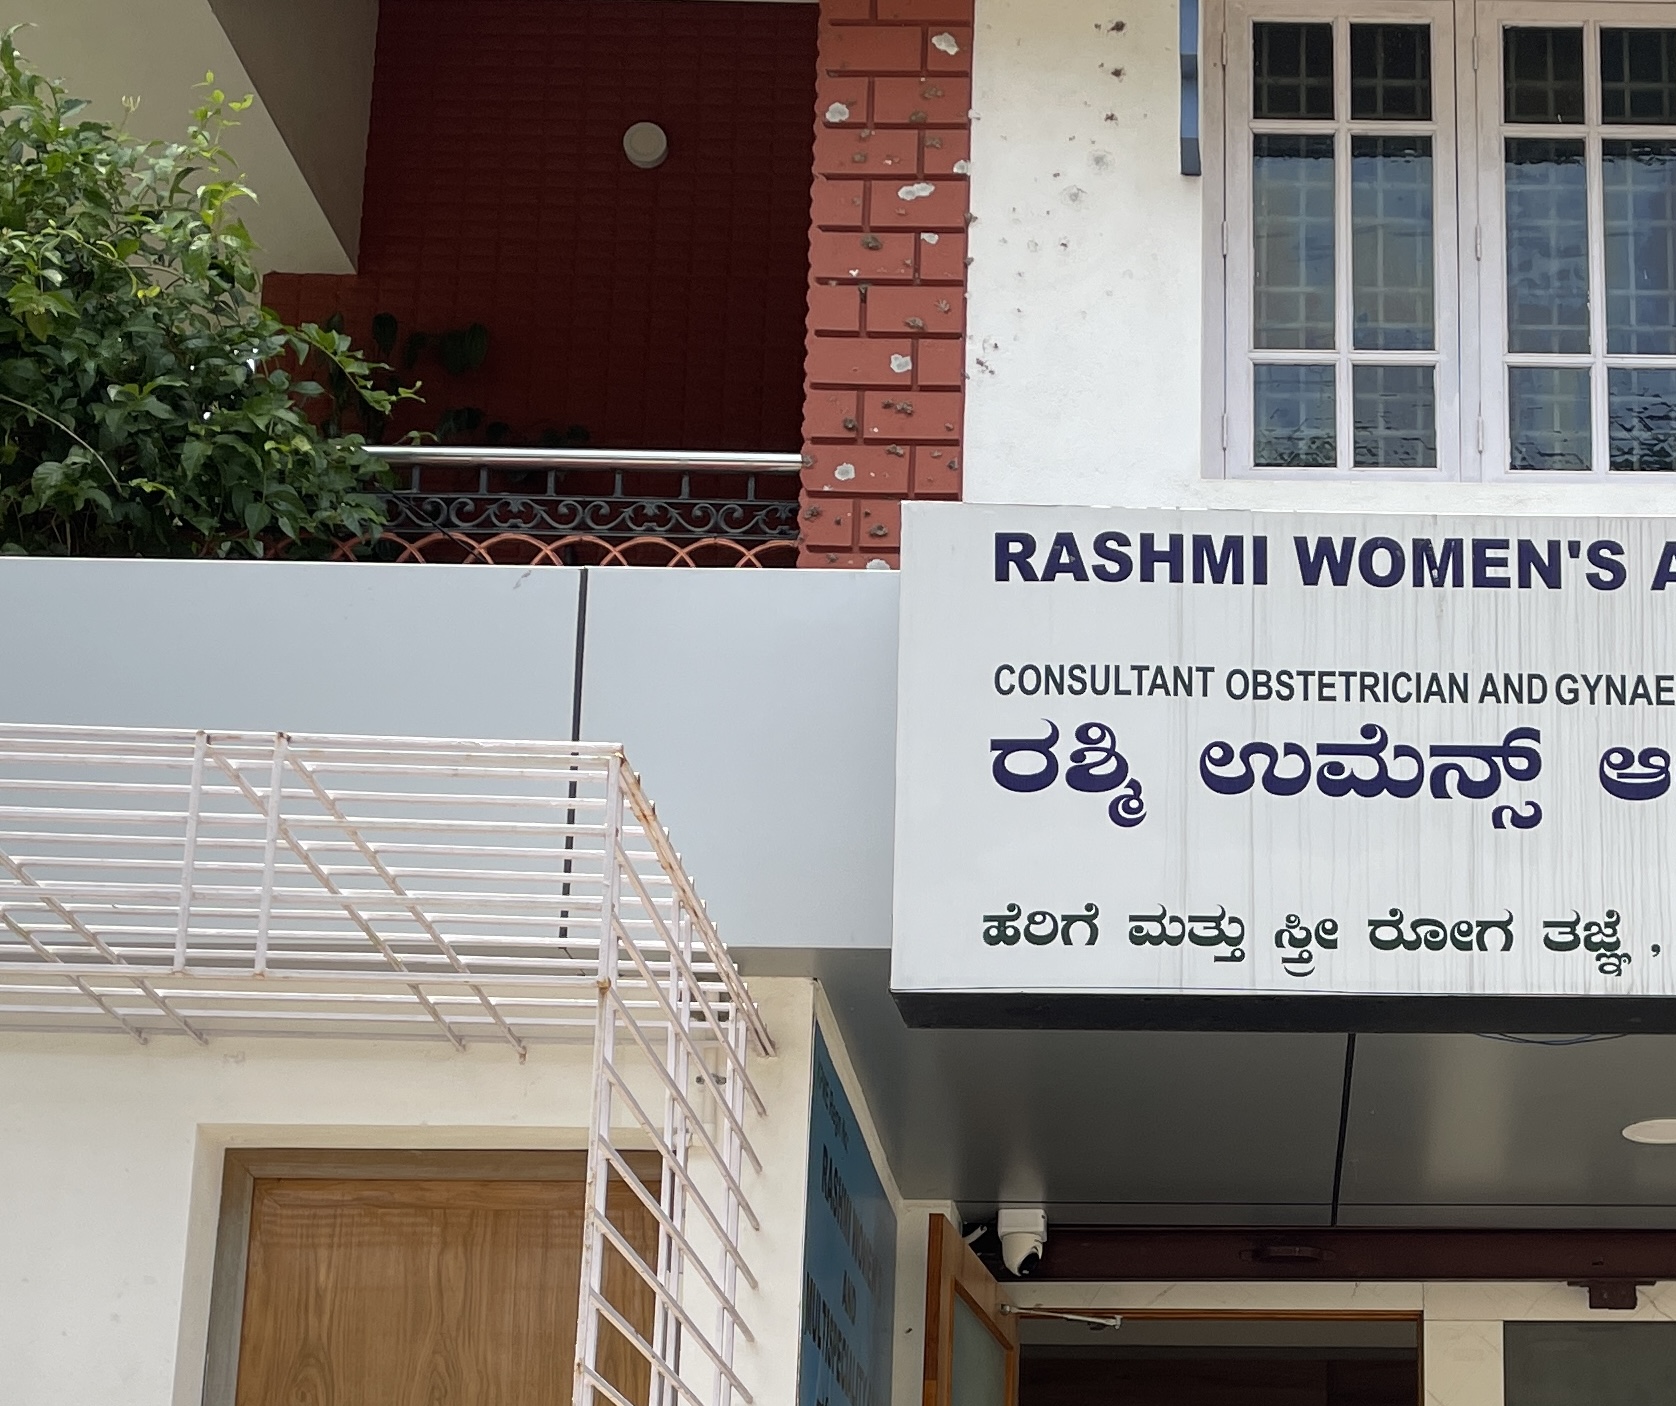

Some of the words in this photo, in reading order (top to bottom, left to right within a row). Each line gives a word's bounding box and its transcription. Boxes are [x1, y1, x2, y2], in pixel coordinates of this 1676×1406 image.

[994, 531, 1268, 586] RASHMI
[1293, 536, 1627, 591] WOMEN'S
[994, 663, 1216, 698] CONSULTANT
[1225, 668, 1469, 704] OBSTETRICIAN
[1478, 672, 1548, 705] AND
[989, 717, 1148, 829] ರಶ್ಮಿ
[1199, 722, 1544, 830] ಉಮೆನ್ಸ್
[982, 902, 1100, 947] ಹೆರಿಗೆ
[1128, 903, 1246, 963] ಮತ್ತು
[1274, 912, 1340, 978] ಸ್ತ್ರೀ
[1367, 907, 1515, 952] ರೋಗ
